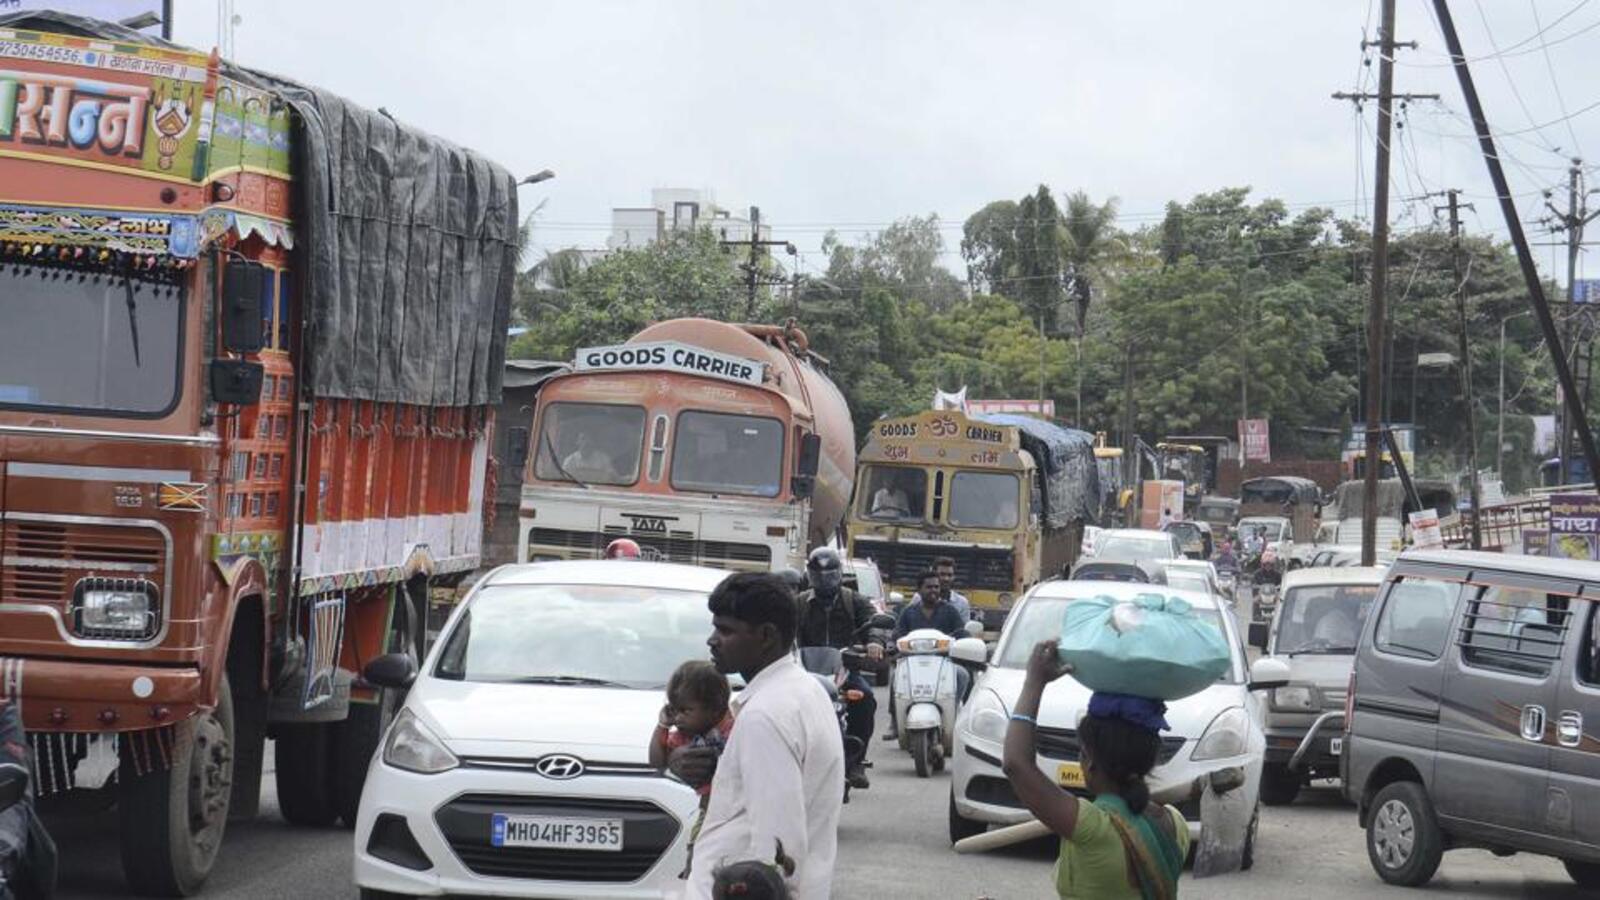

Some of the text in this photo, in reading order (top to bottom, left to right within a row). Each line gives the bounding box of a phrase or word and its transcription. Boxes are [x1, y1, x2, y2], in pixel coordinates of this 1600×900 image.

[586, 347, 753, 380] GOODS CARRIER
[880, 422, 917, 437] GOODS
[965, 426, 1003, 443] CARRIER
[631, 518, 667, 532] TATA
[506, 820, 620, 844] MH04HF3965
